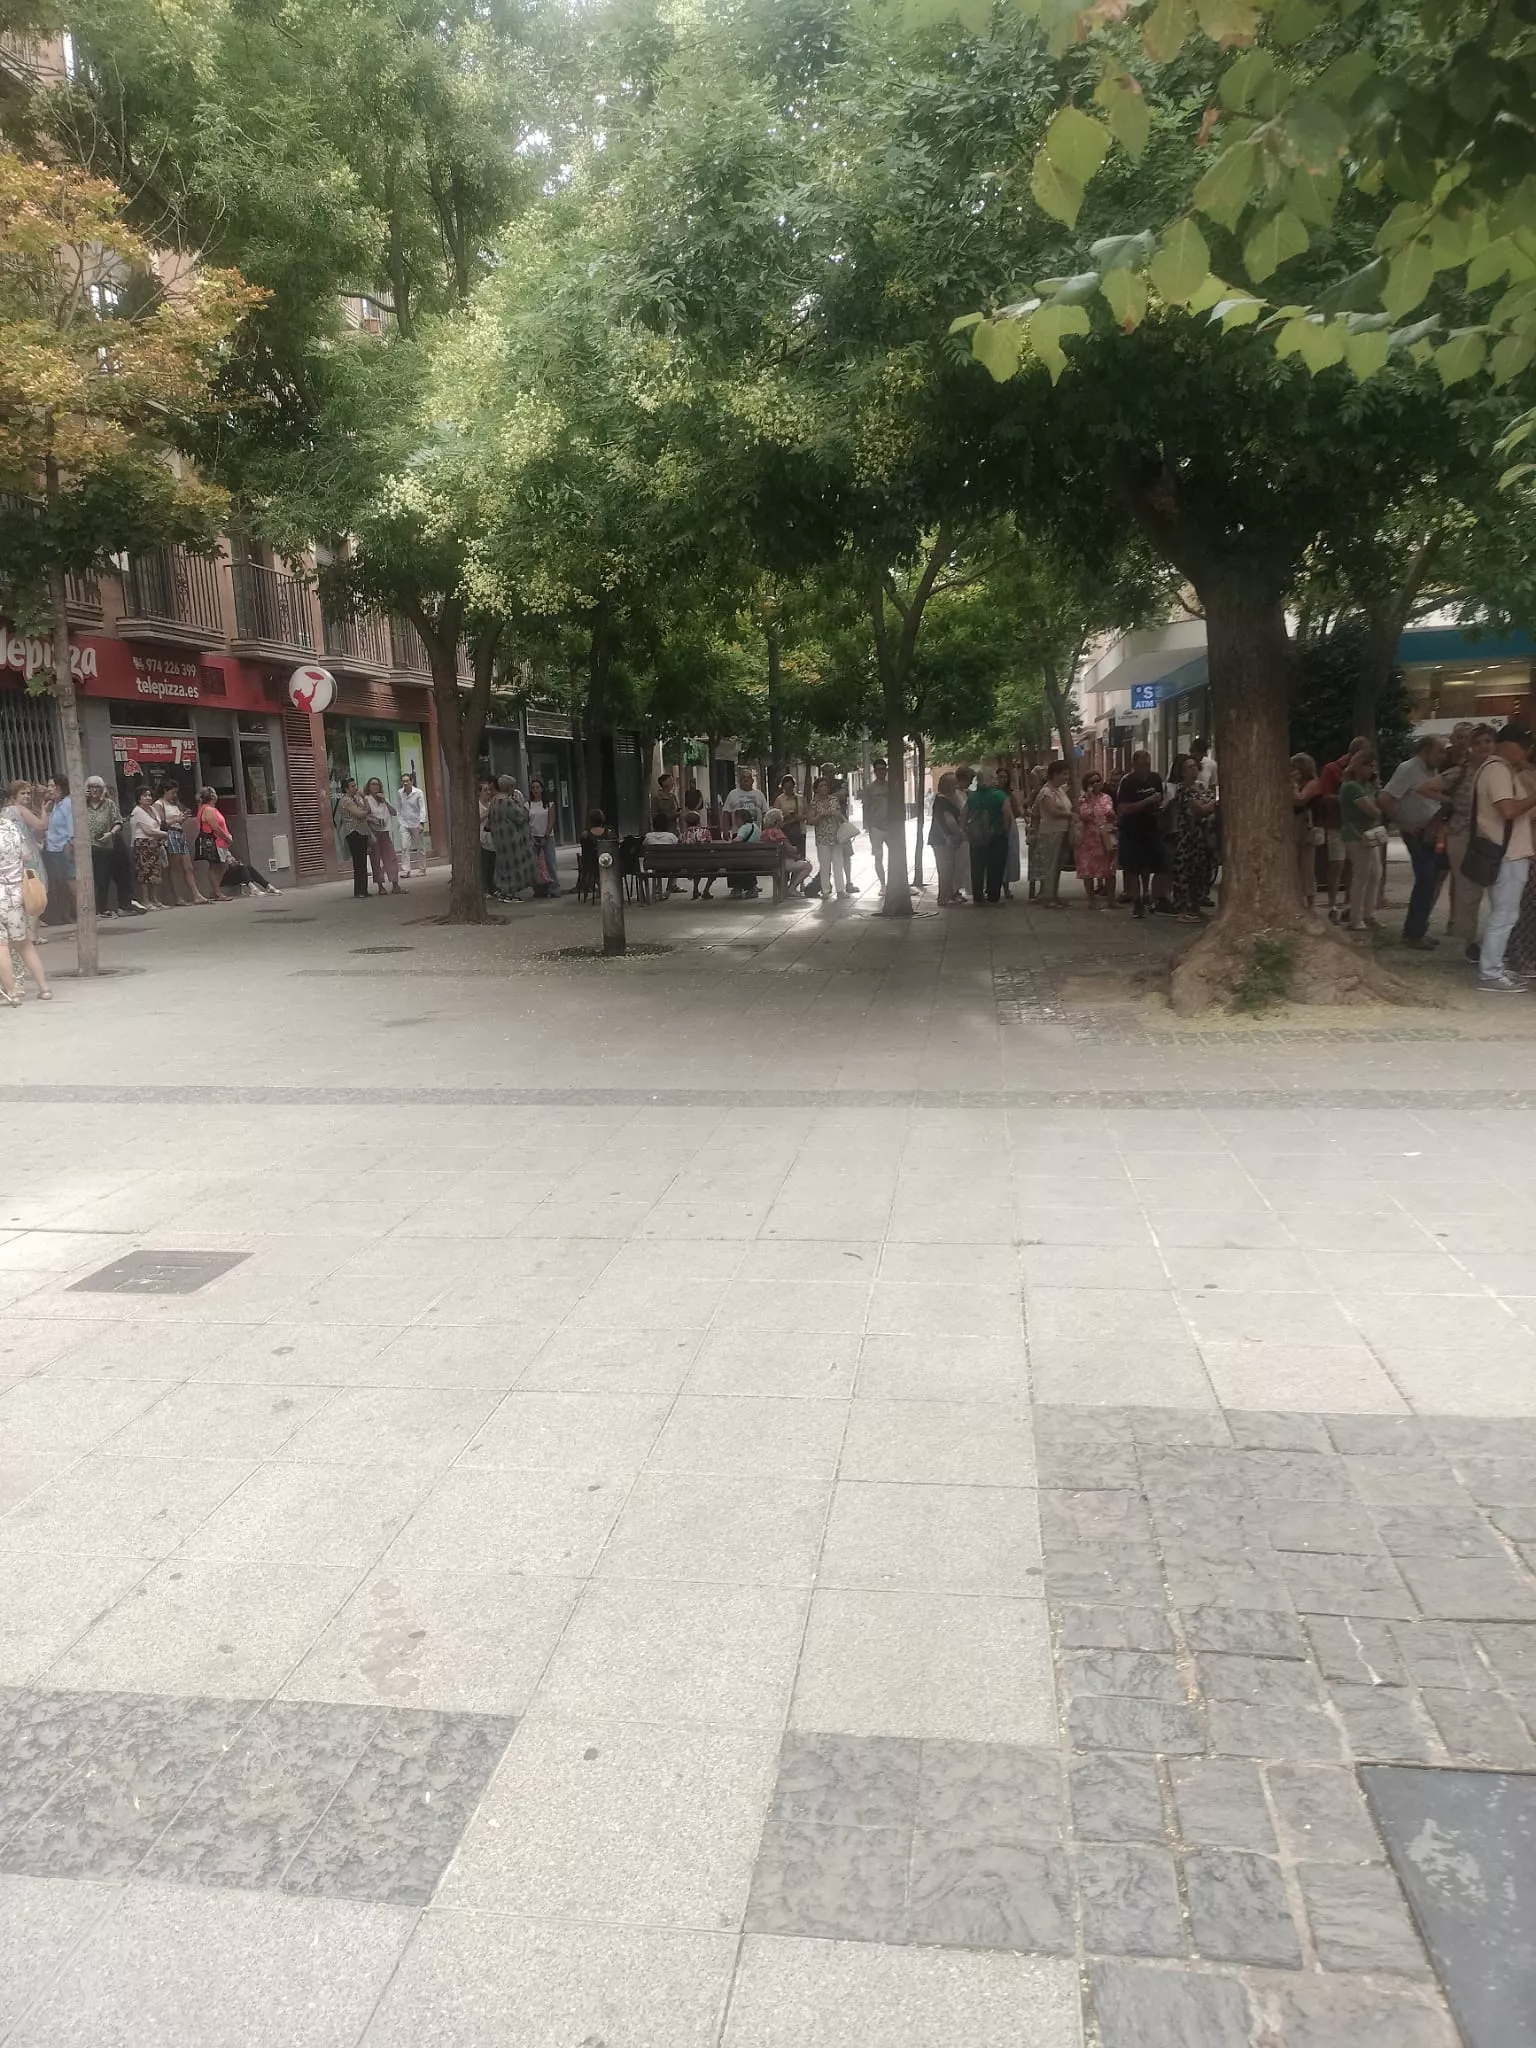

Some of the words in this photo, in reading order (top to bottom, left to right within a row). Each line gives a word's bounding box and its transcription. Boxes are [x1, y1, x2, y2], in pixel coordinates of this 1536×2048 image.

[146, 658, 162, 673] 974
[164, 661, 180, 675] 226
[181, 663, 196, 677] 399
[136, 675, 199, 699] telepizza.es
[1135, 700, 1154, 708] ATM
